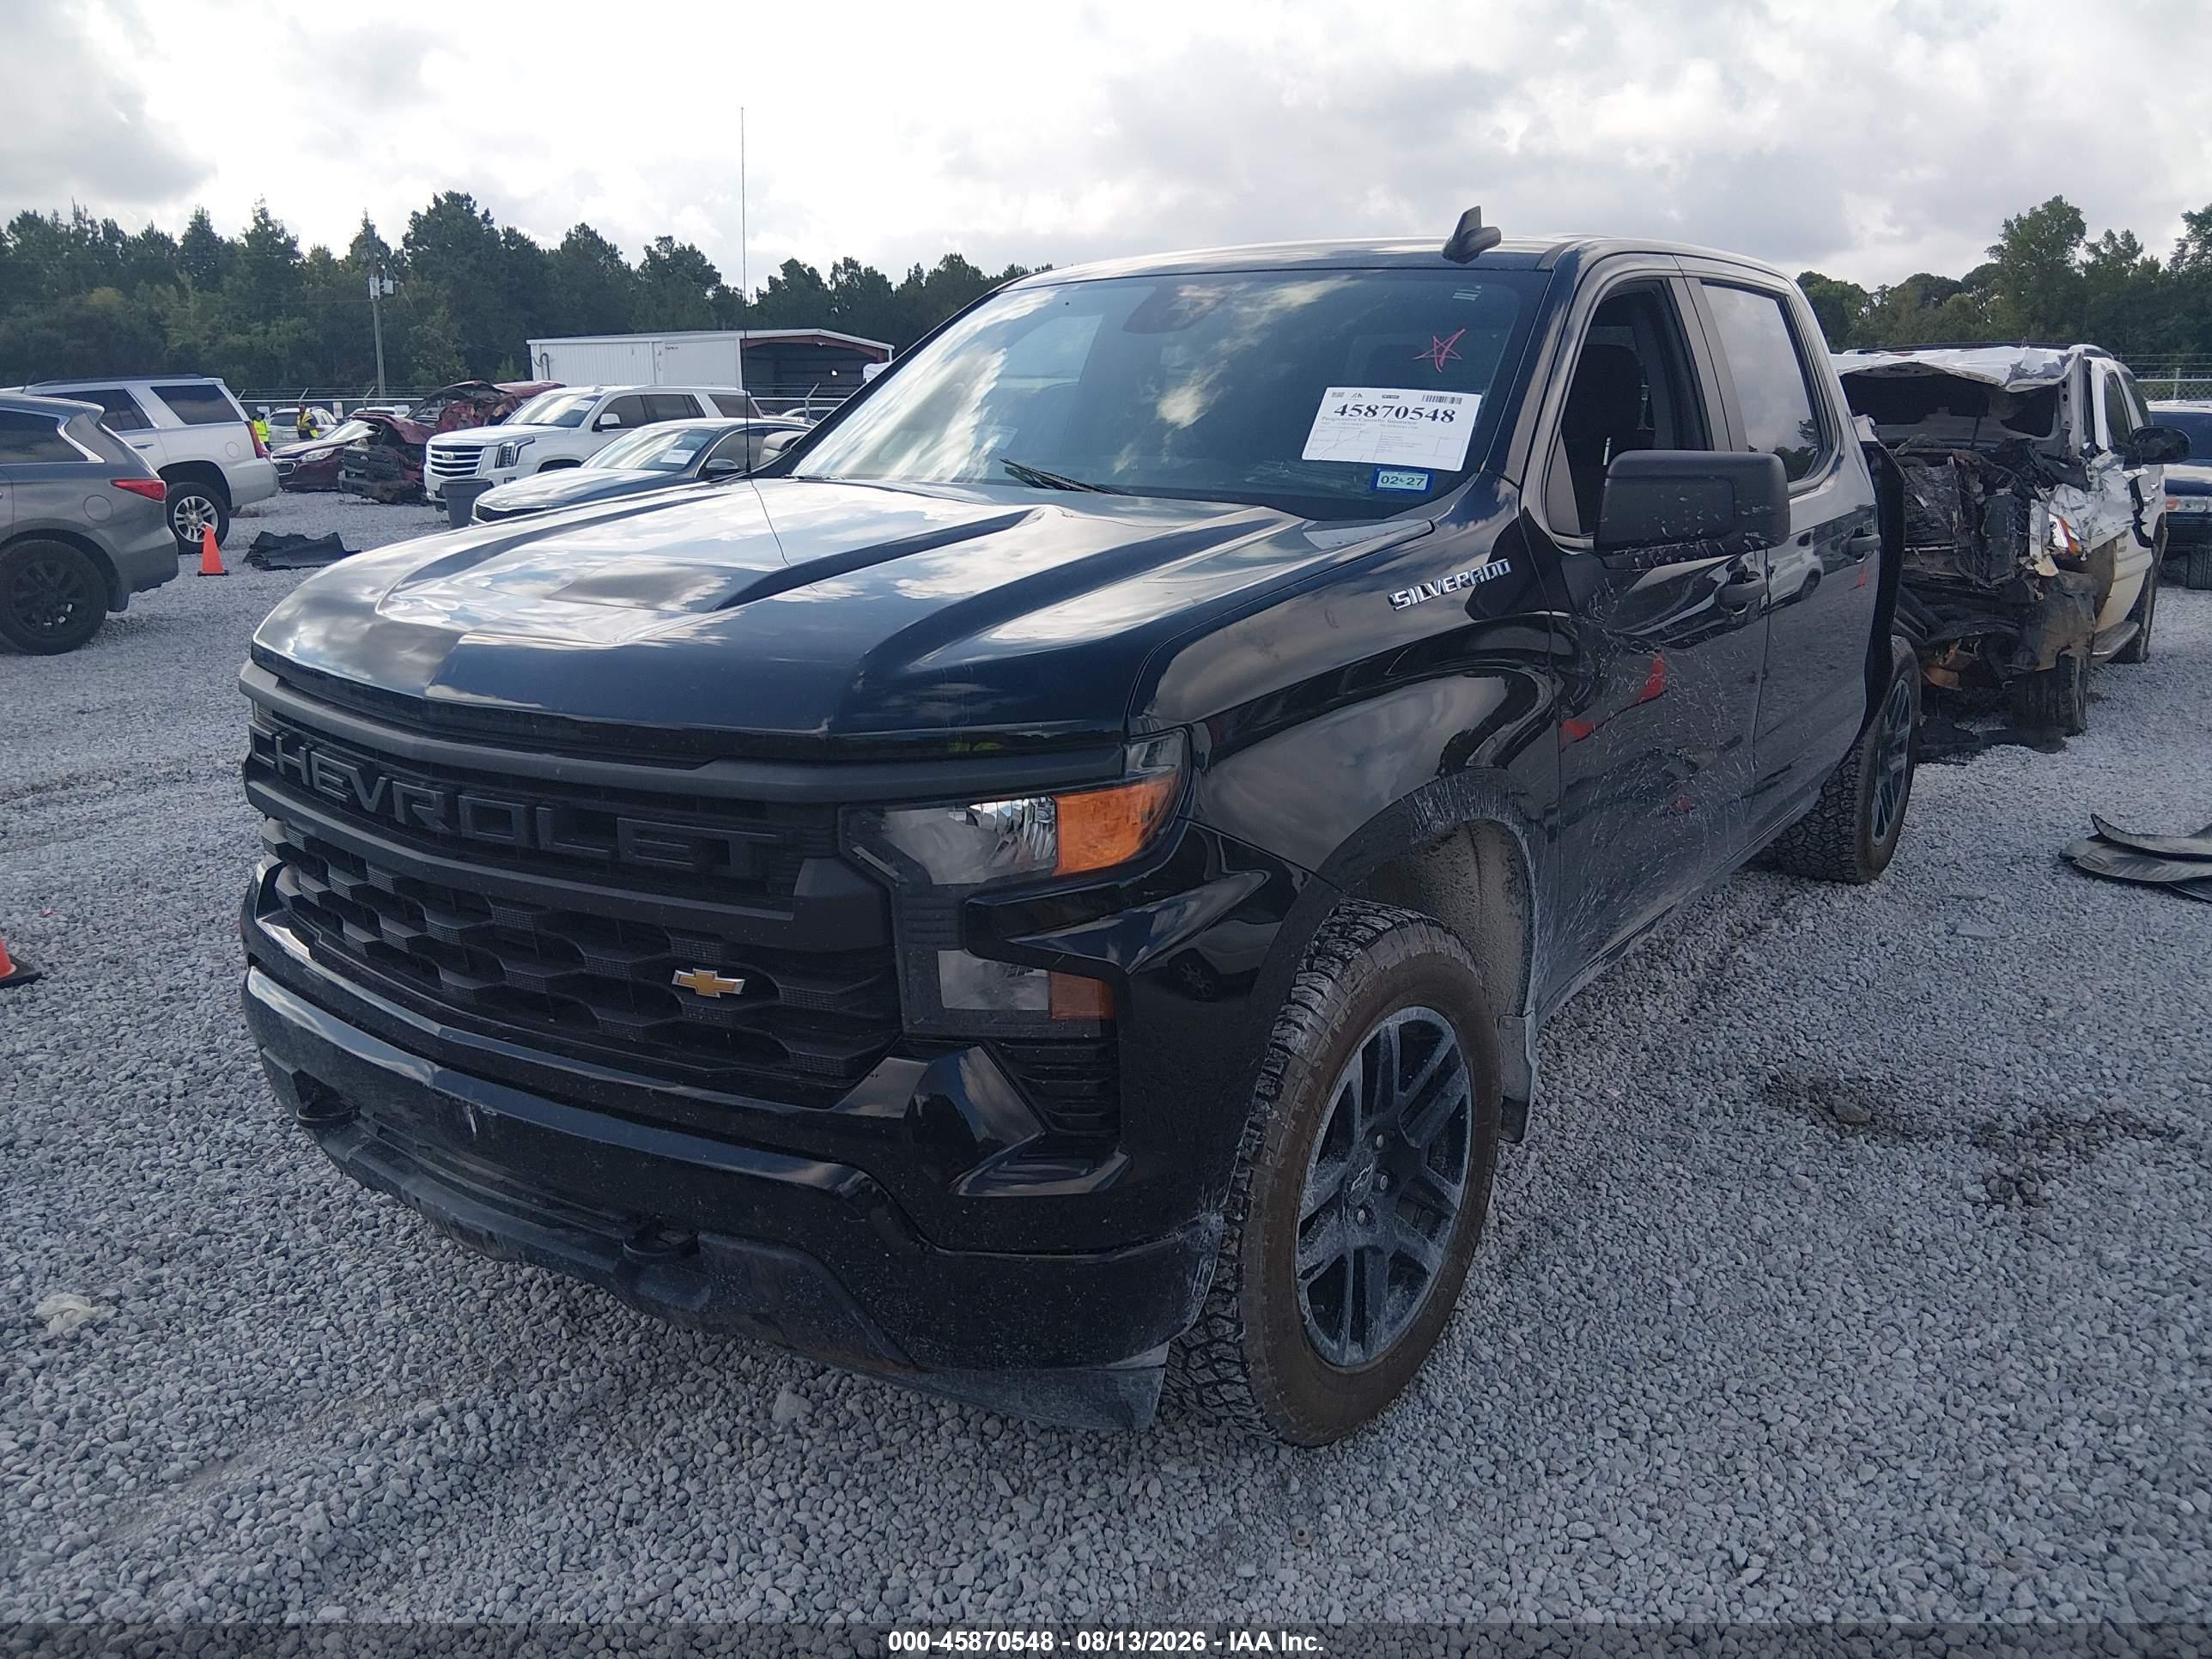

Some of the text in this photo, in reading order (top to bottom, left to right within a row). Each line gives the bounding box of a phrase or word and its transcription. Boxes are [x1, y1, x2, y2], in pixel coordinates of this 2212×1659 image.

[1334, 404, 1455, 423] 45870548
[1389, 558, 1511, 611] SILVERADO
[249, 722, 783, 879] CHEVROLET
